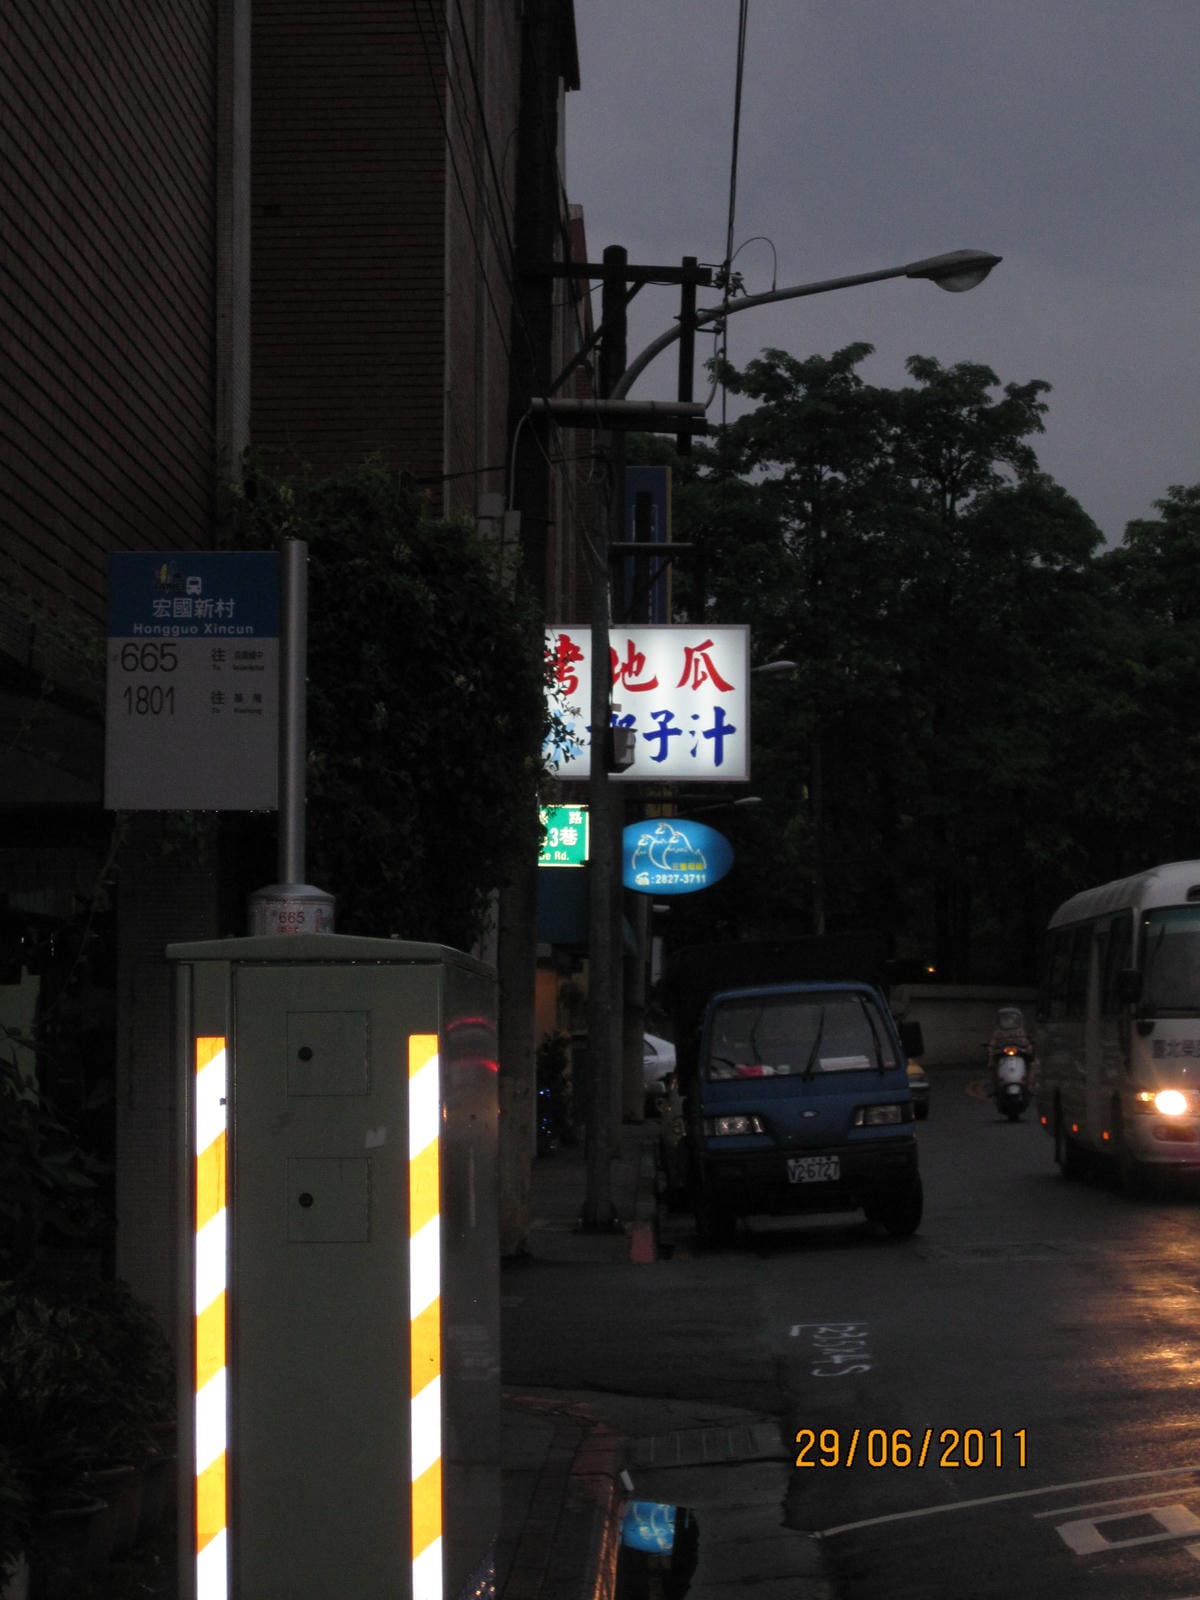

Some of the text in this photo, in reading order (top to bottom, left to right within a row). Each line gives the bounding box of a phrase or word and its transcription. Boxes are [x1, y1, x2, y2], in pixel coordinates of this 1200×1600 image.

[152, 597, 236, 619] 宏國新村
[133, 623, 254, 636] Hongguo Xincun
[120, 642, 178, 672] 665
[123, 685, 175, 715] 1801
[585, 705, 737, 767] 子汁
[554, 850, 569, 861] Rd.
[279, 911, 305, 924] 665
